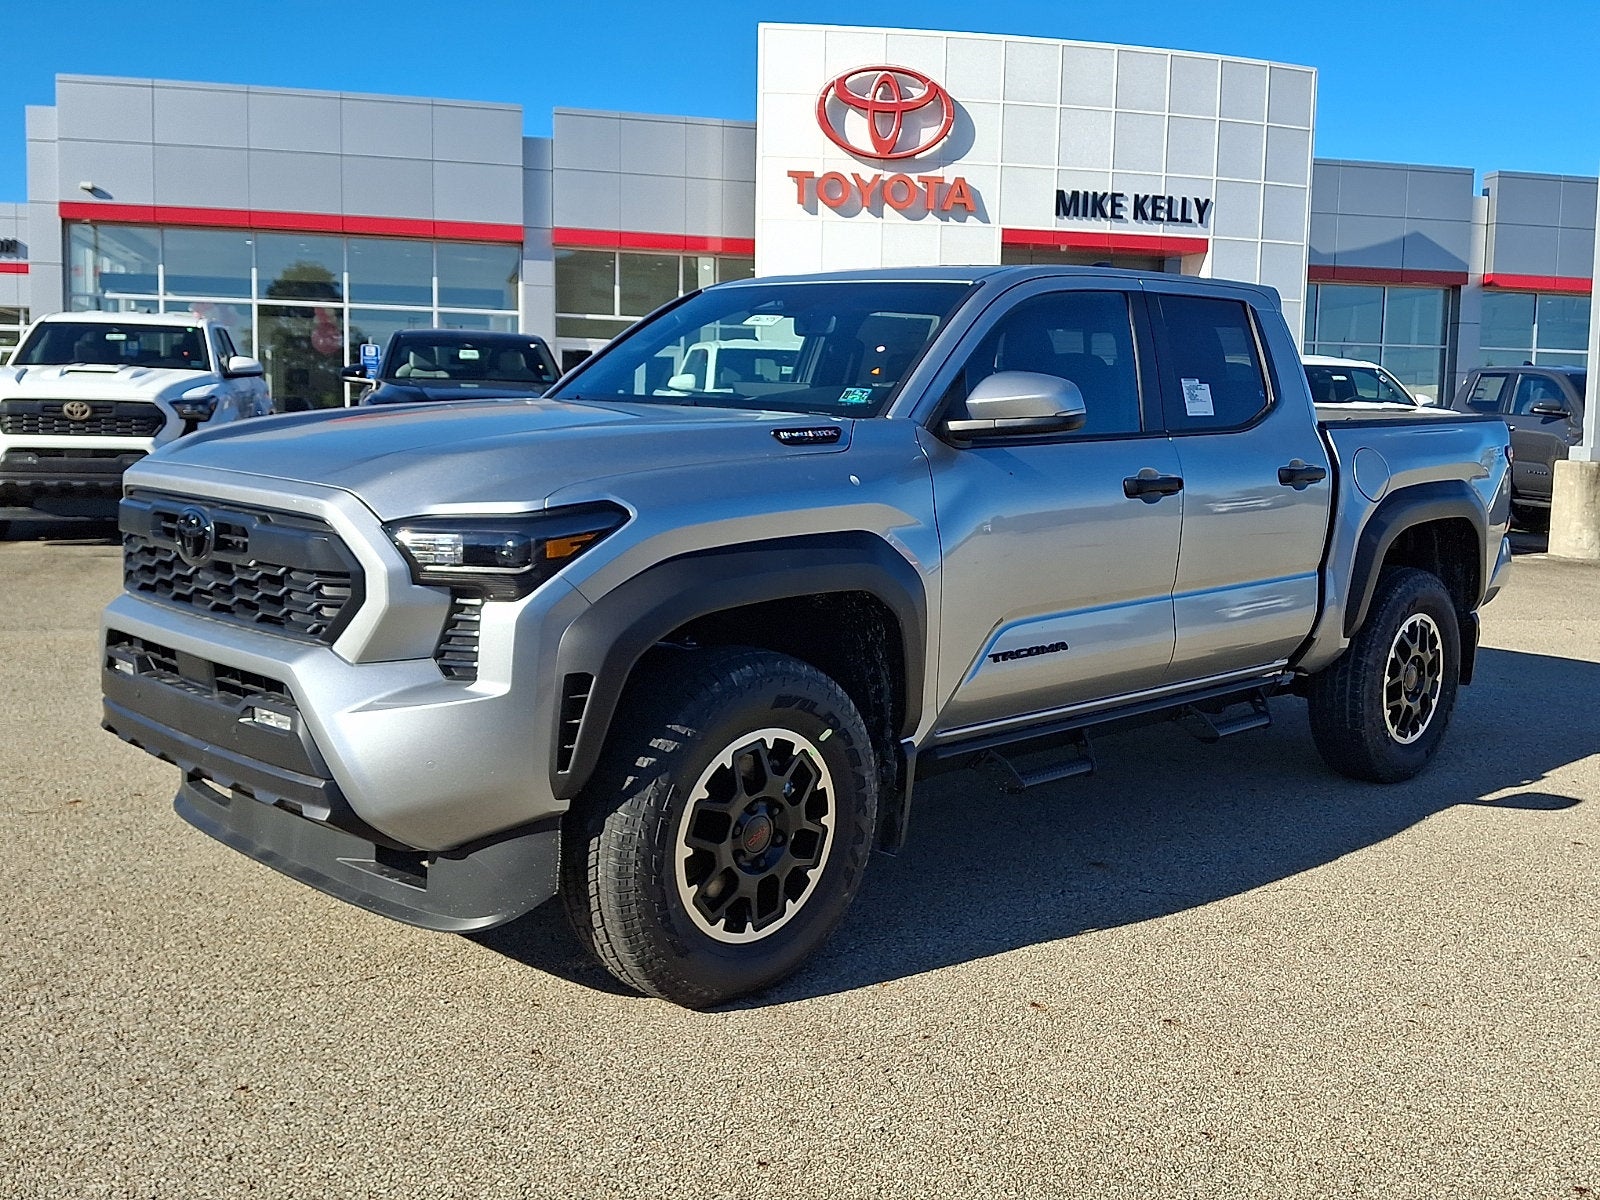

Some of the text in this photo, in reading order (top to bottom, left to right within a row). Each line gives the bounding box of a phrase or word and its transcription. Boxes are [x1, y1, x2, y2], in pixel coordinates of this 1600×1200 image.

[787, 170, 976, 212] TOYOTA
[1055, 189, 1211, 224] MIKE KELLY
[988, 641, 1069, 663] TACOMA
